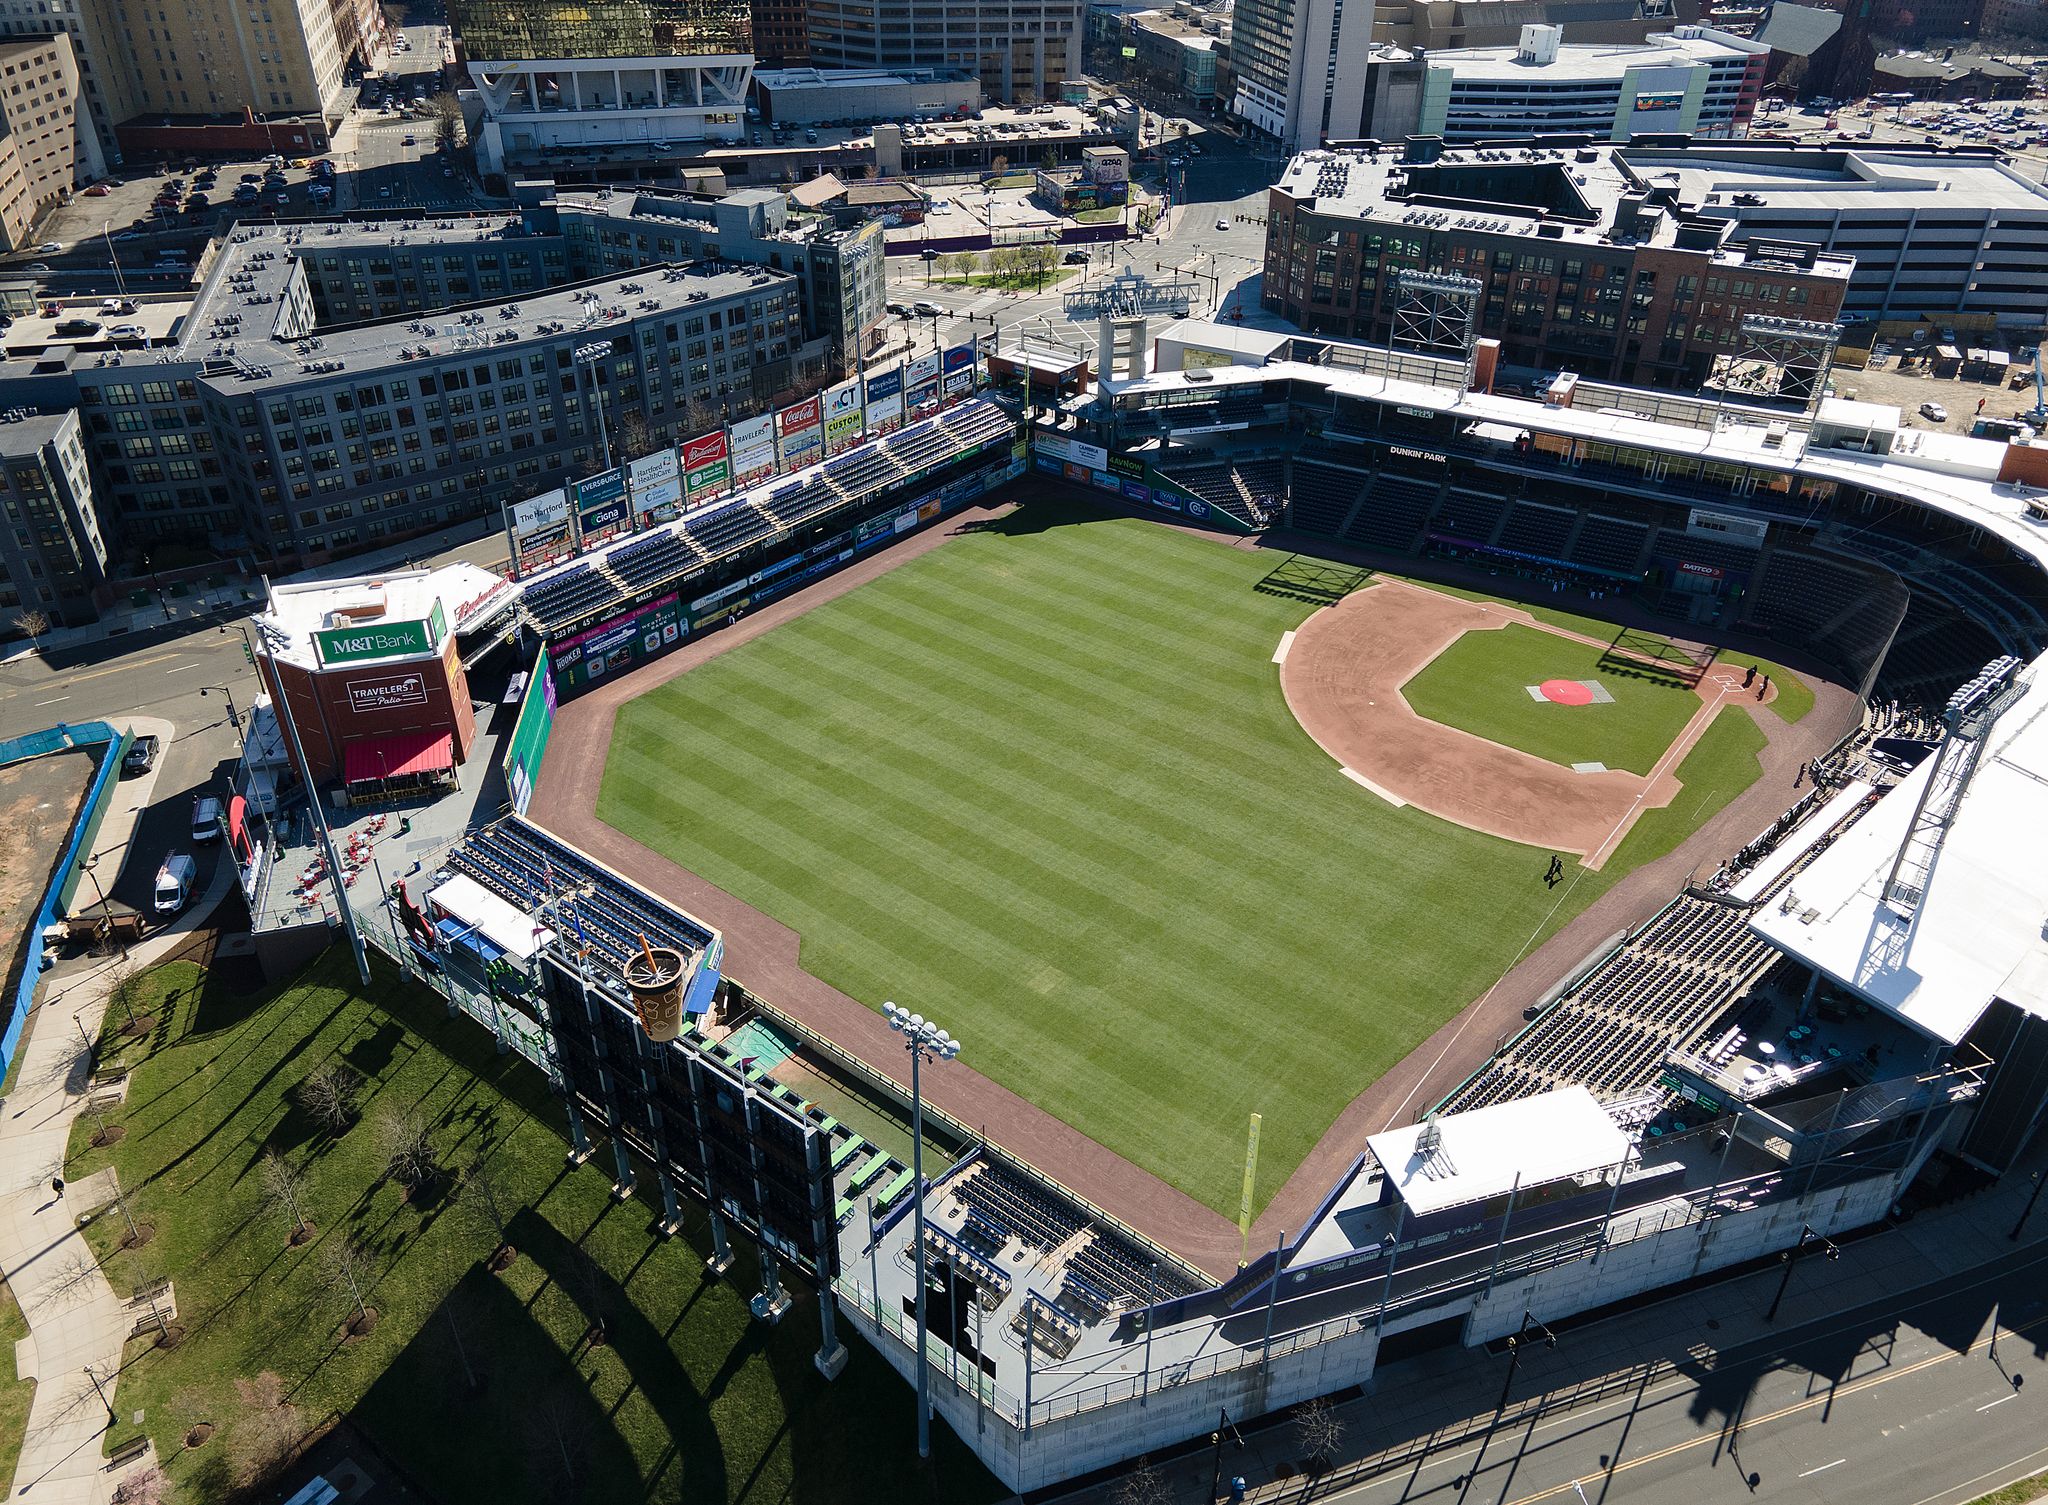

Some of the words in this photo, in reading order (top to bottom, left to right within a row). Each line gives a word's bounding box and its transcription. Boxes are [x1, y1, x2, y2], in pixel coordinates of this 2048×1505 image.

[485, 62, 497, 72] EY
[828, 414, 860, 431] CUSTOM
[735, 428, 765, 445] TRAVELERS
[1390, 446, 1423, 459] DUNKIN'
[1423, 452, 1447, 463] PARK
[637, 462, 662, 478] Hartford
[638, 468, 671, 485] HealthCare
[582, 473, 621, 493] EVERSOURCE
[520, 513, 533, 523] The
[534, 501, 563, 519] Hartford
[725, 553, 740, 563] OUTS
[683, 568, 705, 582] STRIKES
[1683, 563, 1713, 573] DATTCO
[635, 591, 653, 603] BALLS
[567, 623, 577, 634] PM
[641, 612, 675, 630] WESTFIELD
[332, 636, 374, 655] M&T
[375, 632, 416, 649] Bank
[556, 649, 581, 670] HOOKER
[353, 684, 408, 698] TRAVELERS
[377, 696, 402, 705] Patio
